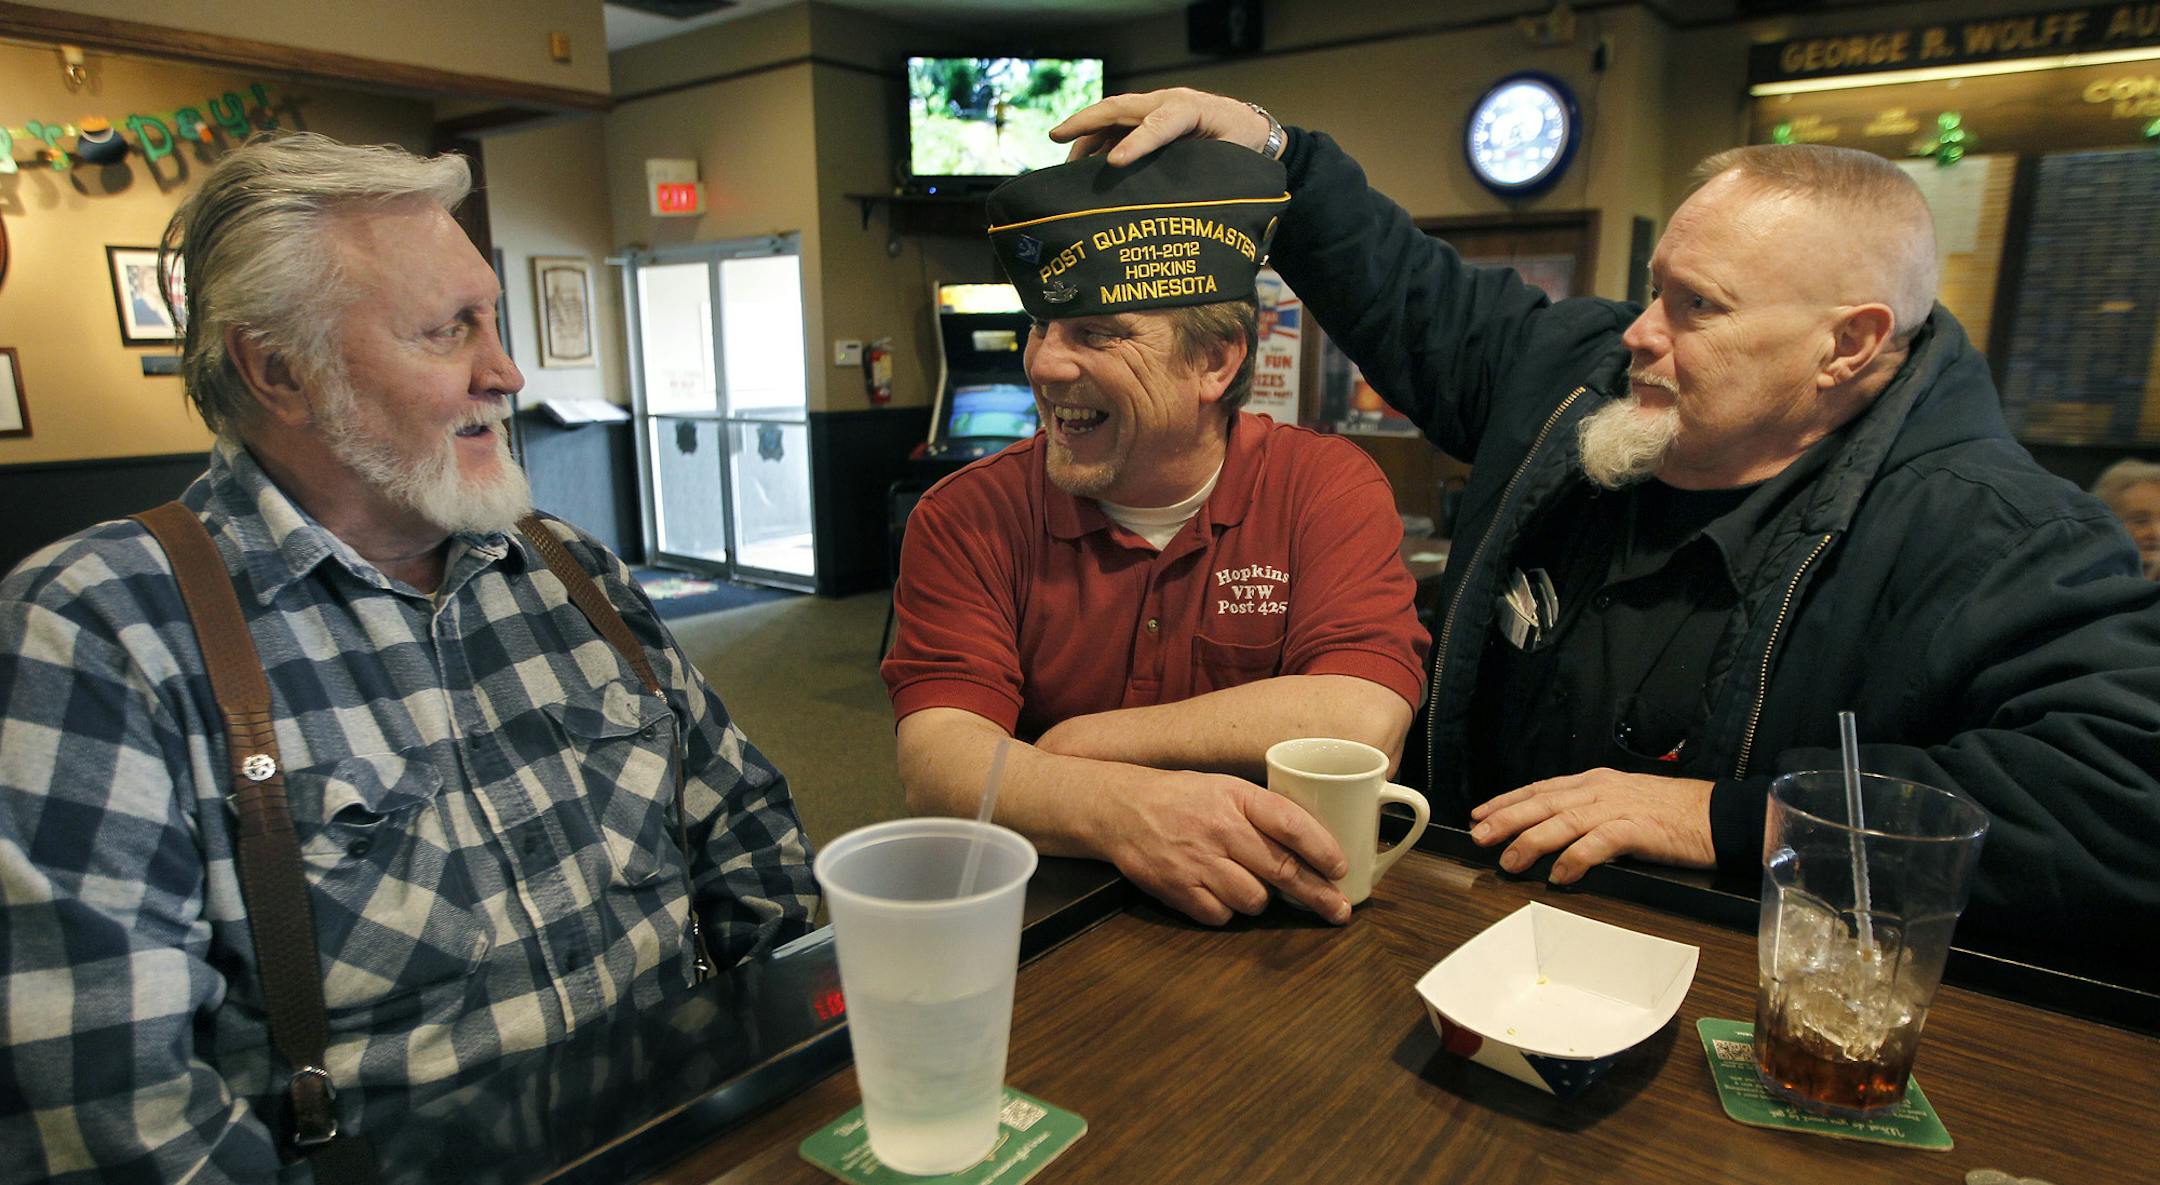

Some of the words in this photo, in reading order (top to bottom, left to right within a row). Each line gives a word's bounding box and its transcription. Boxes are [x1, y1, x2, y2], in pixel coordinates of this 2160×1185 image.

[1780, 30, 1911, 73] GEORGE
[1962, 11, 2089, 54] WOLFF
[1040, 240, 1087, 285] POST
[1092, 216, 1257, 262] QUARTERMASTER
[1119, 241, 1201, 264] 2011-2012
[1125, 259, 1197, 280] HOPKINS
[1100, 274, 1217, 305] MINNESOTA
[1263, 354, 1292, 369] FUN
[1215, 564, 1290, 586] Hopkins
[1231, 584, 1274, 600] VFW
[1217, 600, 1255, 615] Post
[1257, 600, 1288, 616] 425
